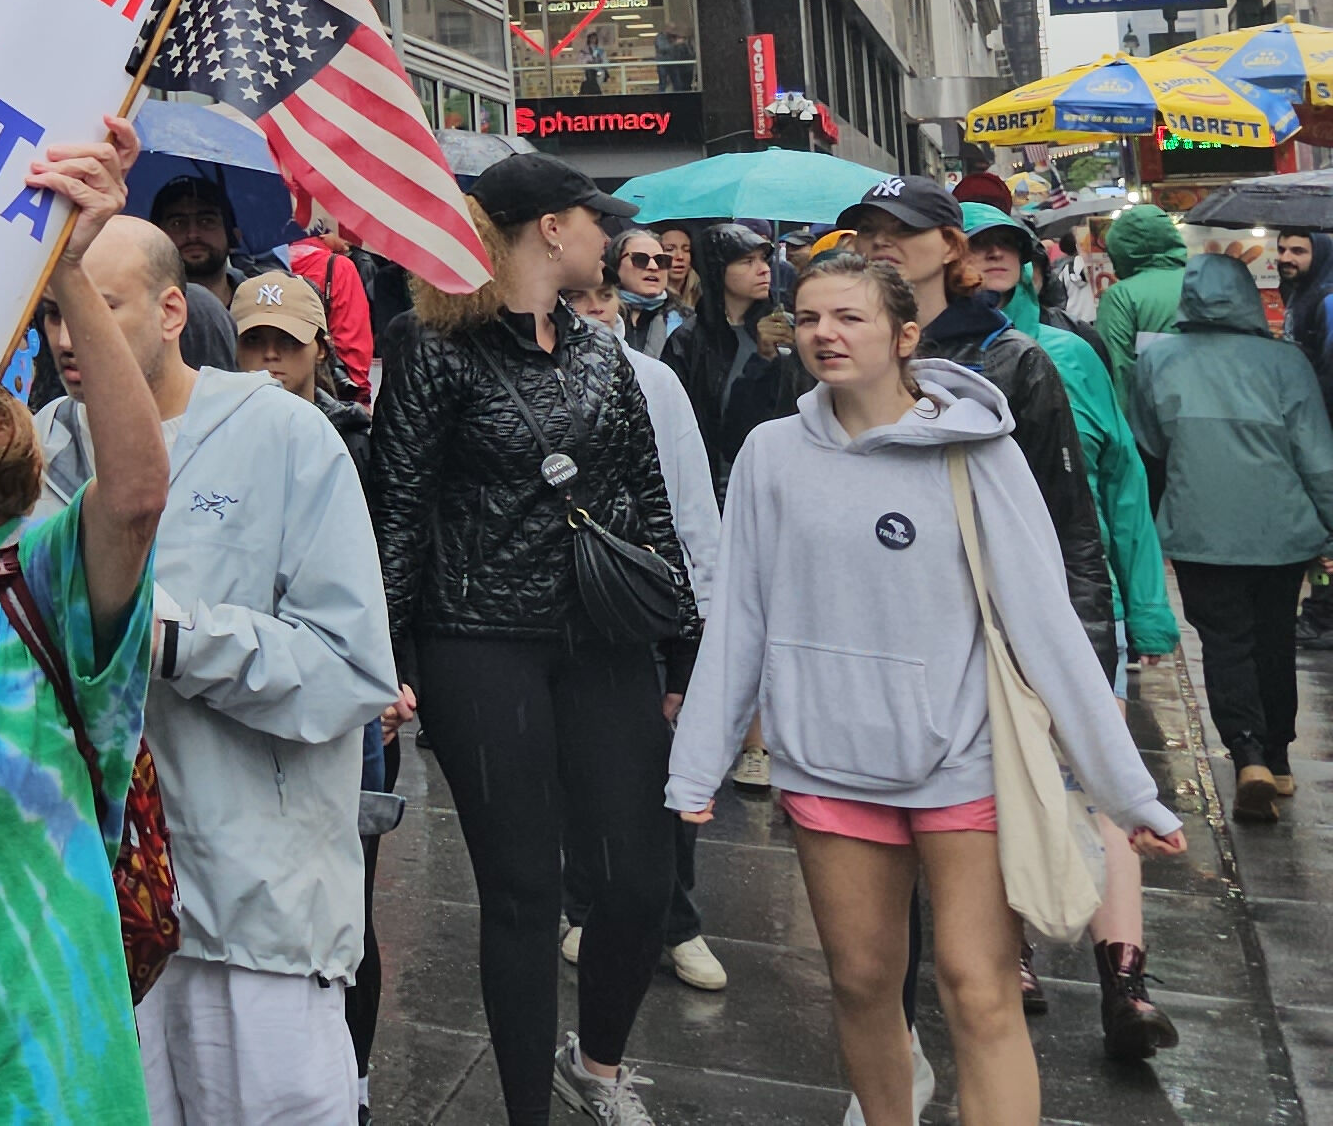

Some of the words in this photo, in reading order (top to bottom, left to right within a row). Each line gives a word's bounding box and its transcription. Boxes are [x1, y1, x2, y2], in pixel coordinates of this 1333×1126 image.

[573, 1, 600, 12] your
[539, 110, 671, 138] pharmacy
[1167, 112, 1262, 139] SABRETT
[872, 177, 906, 197] NY
[0, 184, 57, 243] A
[256, 283, 284, 306] NY
